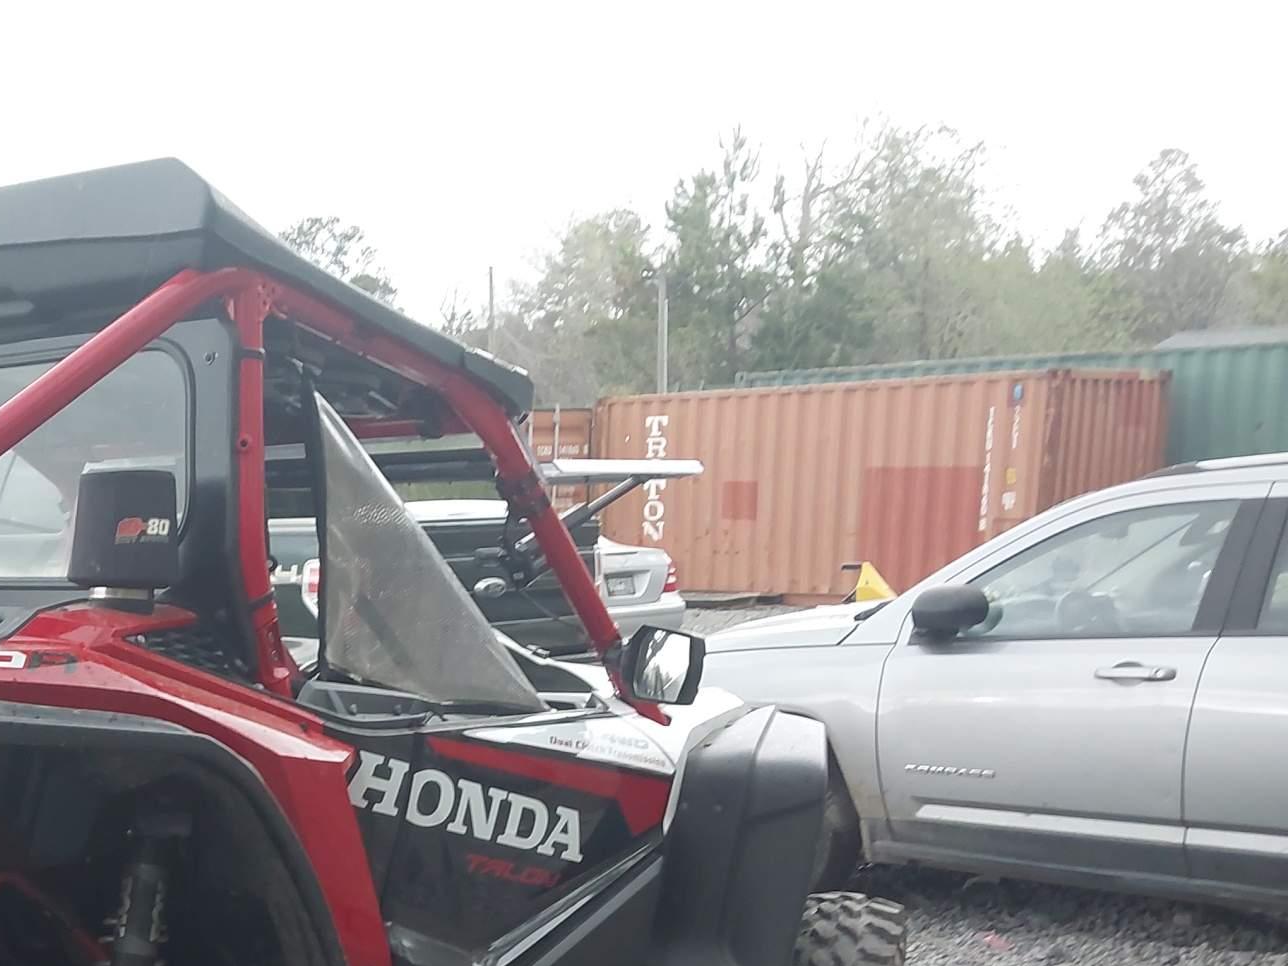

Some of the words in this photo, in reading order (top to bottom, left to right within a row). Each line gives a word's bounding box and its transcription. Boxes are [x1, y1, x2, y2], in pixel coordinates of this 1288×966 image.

[147, 518, 170, 536] 80
[642, 415, 669, 542] TRTON
[347, 750, 584, 863] HONDA
